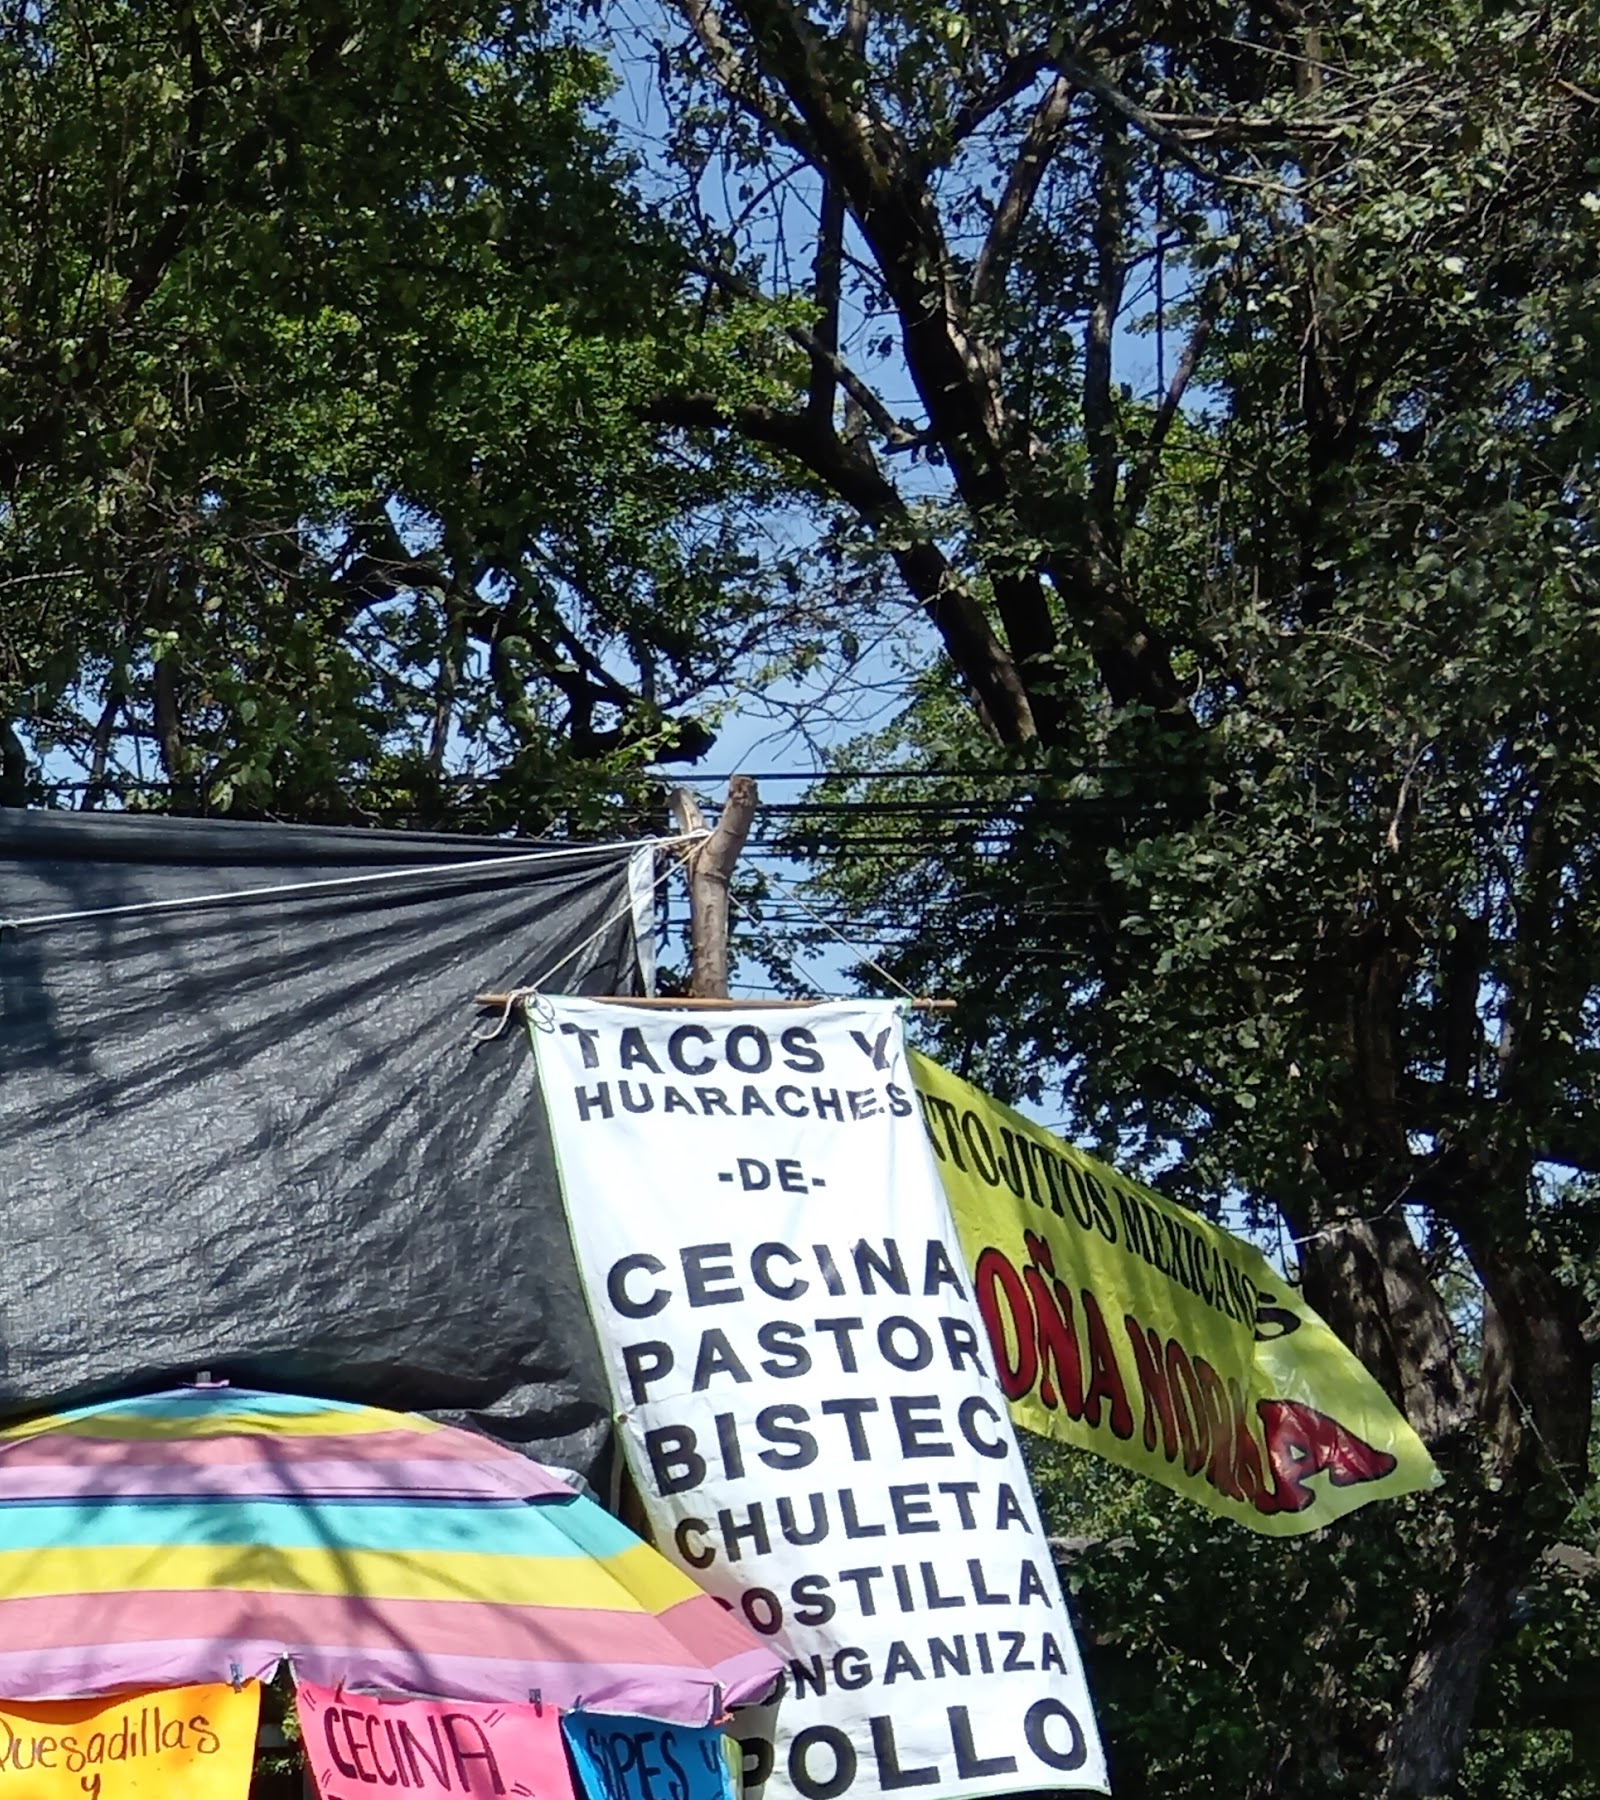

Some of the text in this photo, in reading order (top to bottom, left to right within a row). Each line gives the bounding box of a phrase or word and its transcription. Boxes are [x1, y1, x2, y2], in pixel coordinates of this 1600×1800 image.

[561, 1023, 893, 1077] TACOS Y
[574, 1077, 913, 1122] HUARACHES
[717, 1156, 828, 1195] -DE-
[916, 1089, 1117, 1243] NTOJITOS
[606, 1237, 966, 1320] CECINA
[621, 1313, 994, 1406] PASTOR
[976, 1229, 1134, 1441] OÑA
[645, 1394, 1011, 1497] BISTEC
[675, 1480, 1034, 1571] CHULETA
[762, 1629, 1068, 1706] NGANIZA
